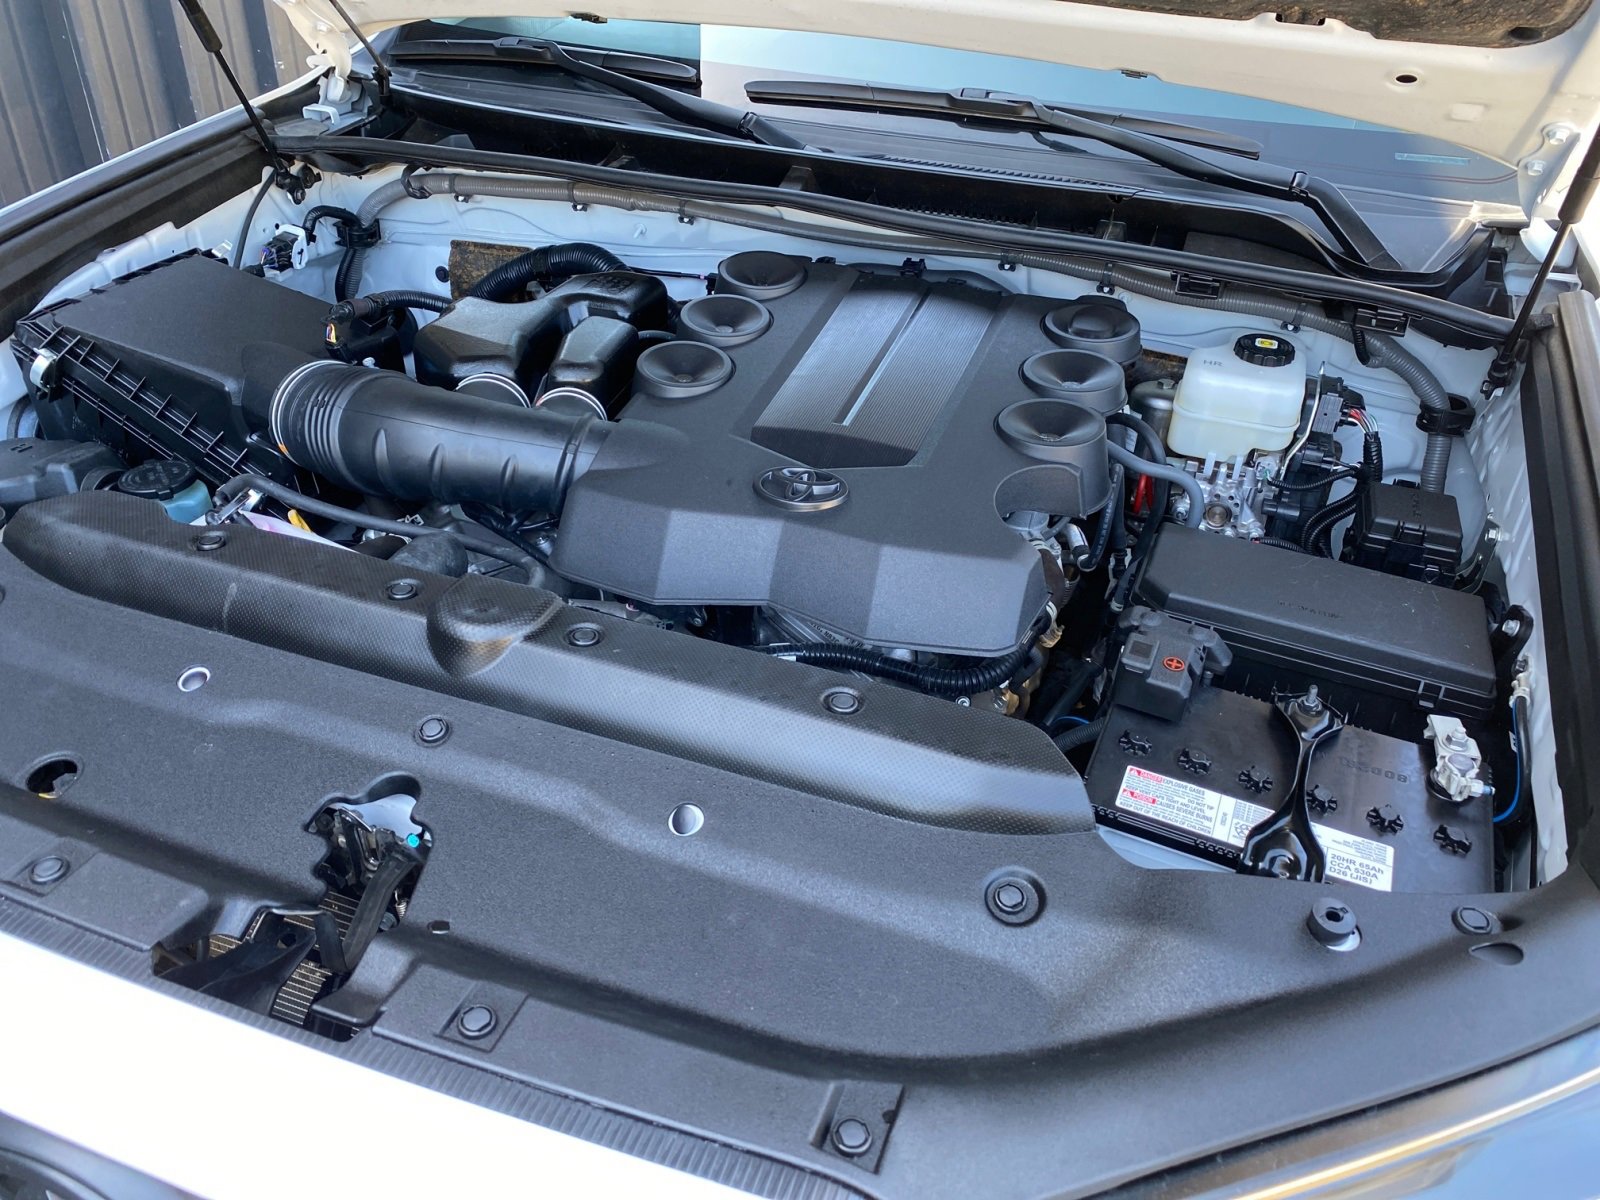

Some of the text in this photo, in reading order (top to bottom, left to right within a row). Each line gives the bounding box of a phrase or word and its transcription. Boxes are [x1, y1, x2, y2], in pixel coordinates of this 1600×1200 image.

[1163, 777, 1189, 791] EXPLOSIVE
[1189, 786, 1206, 796] GASES
[1157, 799, 1176, 810] CAUSES
[1176, 805, 1195, 817] SEVERE
[1195, 811, 1213, 823] BURNS
[1165, 796, 1180, 806] TIGHT
[1180, 801, 1191, 809] AND
[1190, 804, 1205, 814] LEVEL
[1119, 800, 1133, 810] KEEP
[1133, 804, 1143, 812] OUT
[1143, 807, 1151, 815] OF
[1151, 810, 1161, 819] THE
[1161, 813, 1179, 825] REACH
[1186, 822, 1212, 835] CHILDREN
[1330, 853, 1384, 875] 20HR 65Ah
[1330, 860, 1379, 880] CCA 530A
[1329, 866, 1373, 885] D26 (JIS)
